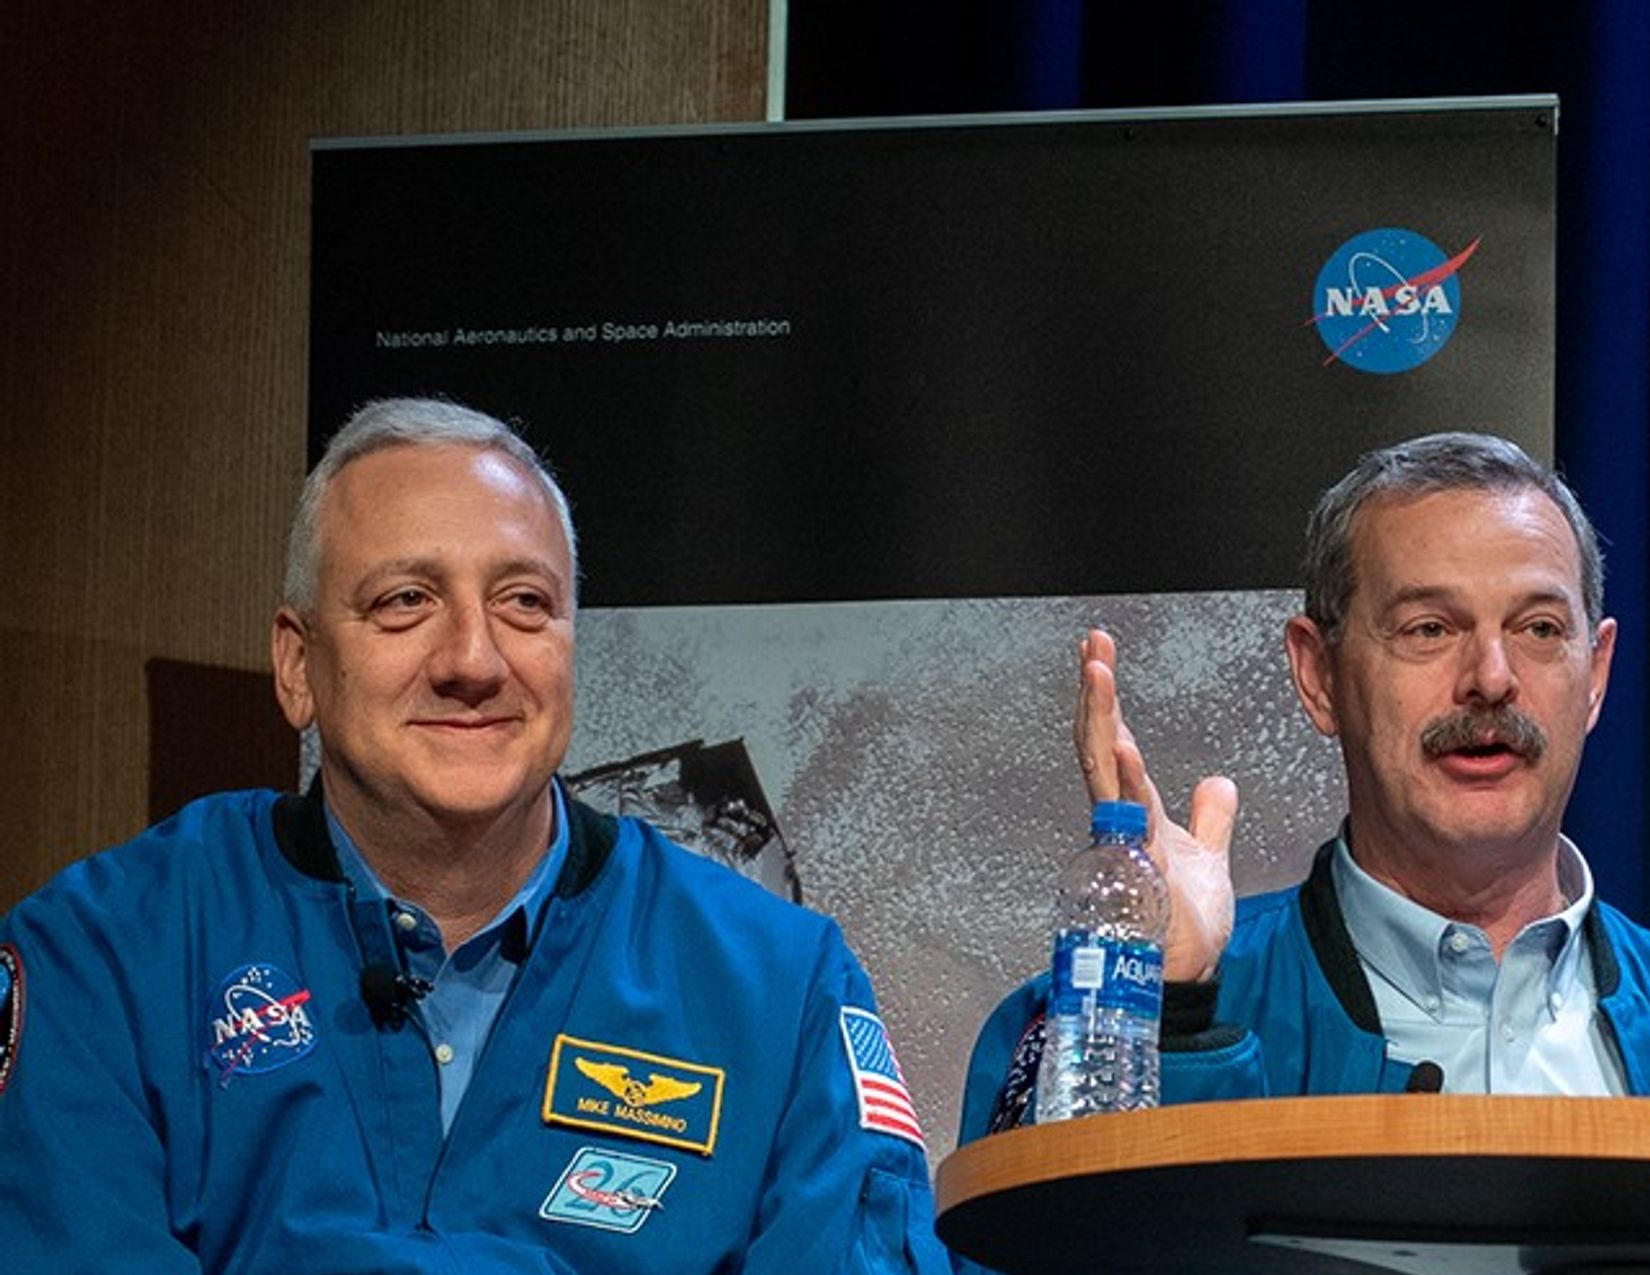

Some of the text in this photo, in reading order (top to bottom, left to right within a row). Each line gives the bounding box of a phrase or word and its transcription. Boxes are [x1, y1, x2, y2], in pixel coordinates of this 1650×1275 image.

[1325, 285, 1453, 316] NASA
[376, 318, 791, 348] National Aeronautics and Space Administration
[213, 1004, 313, 1044] NASA
